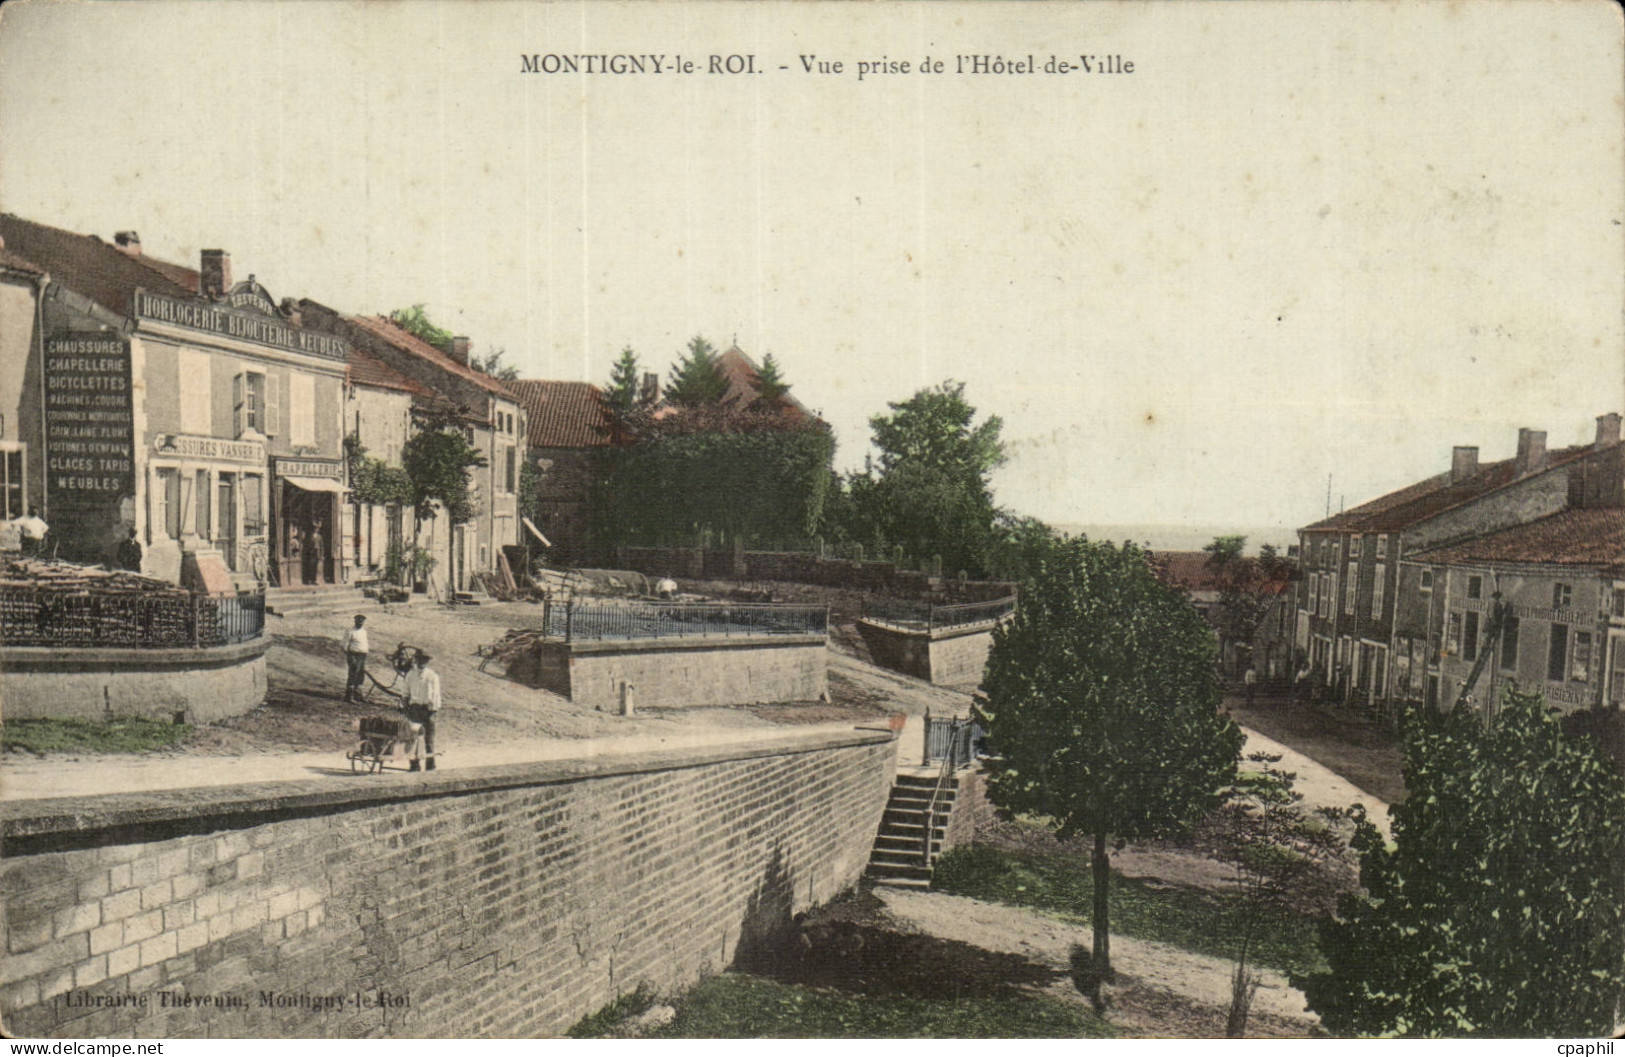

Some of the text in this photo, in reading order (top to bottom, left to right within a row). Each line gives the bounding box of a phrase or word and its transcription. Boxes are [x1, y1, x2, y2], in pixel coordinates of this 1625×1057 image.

[143, 296, 344, 358] HORLOGERIE BIJOUTERIE MEUBLES
[49, 341, 124, 354] CHAUSSURES
[49, 358, 125, 371] CHAPELLERIE
[49, 376, 126, 390] BICYCLETTES
[99, 459, 130, 472] TAPIS
[58, 477, 120, 490] MEUBLES
